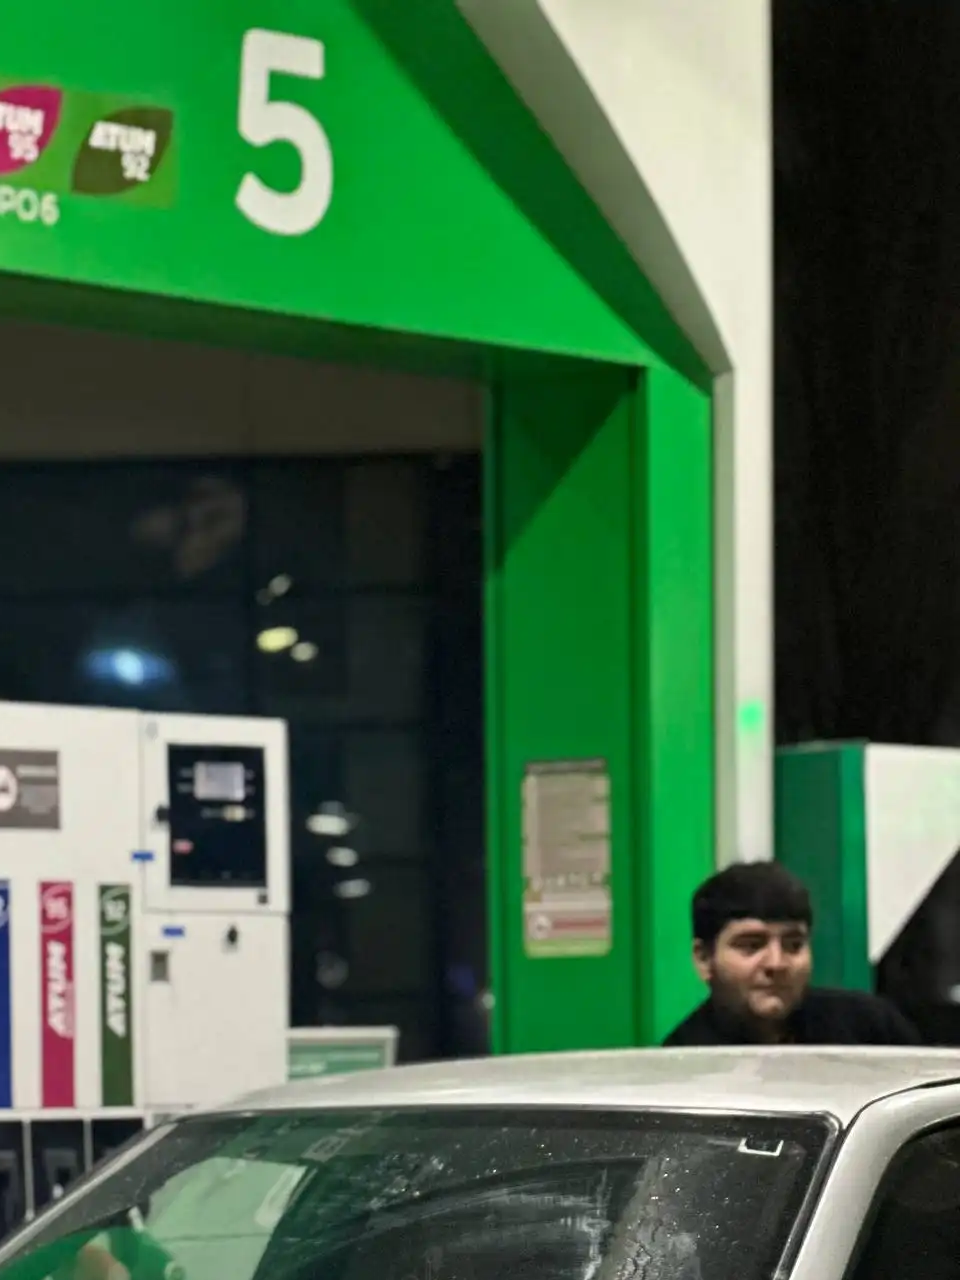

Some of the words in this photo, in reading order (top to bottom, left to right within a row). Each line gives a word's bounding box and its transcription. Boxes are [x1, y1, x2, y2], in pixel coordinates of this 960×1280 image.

[235, 27, 334, 236] 5
[8, 133, 39, 162] 95
[121, 152, 150, 182] 92
